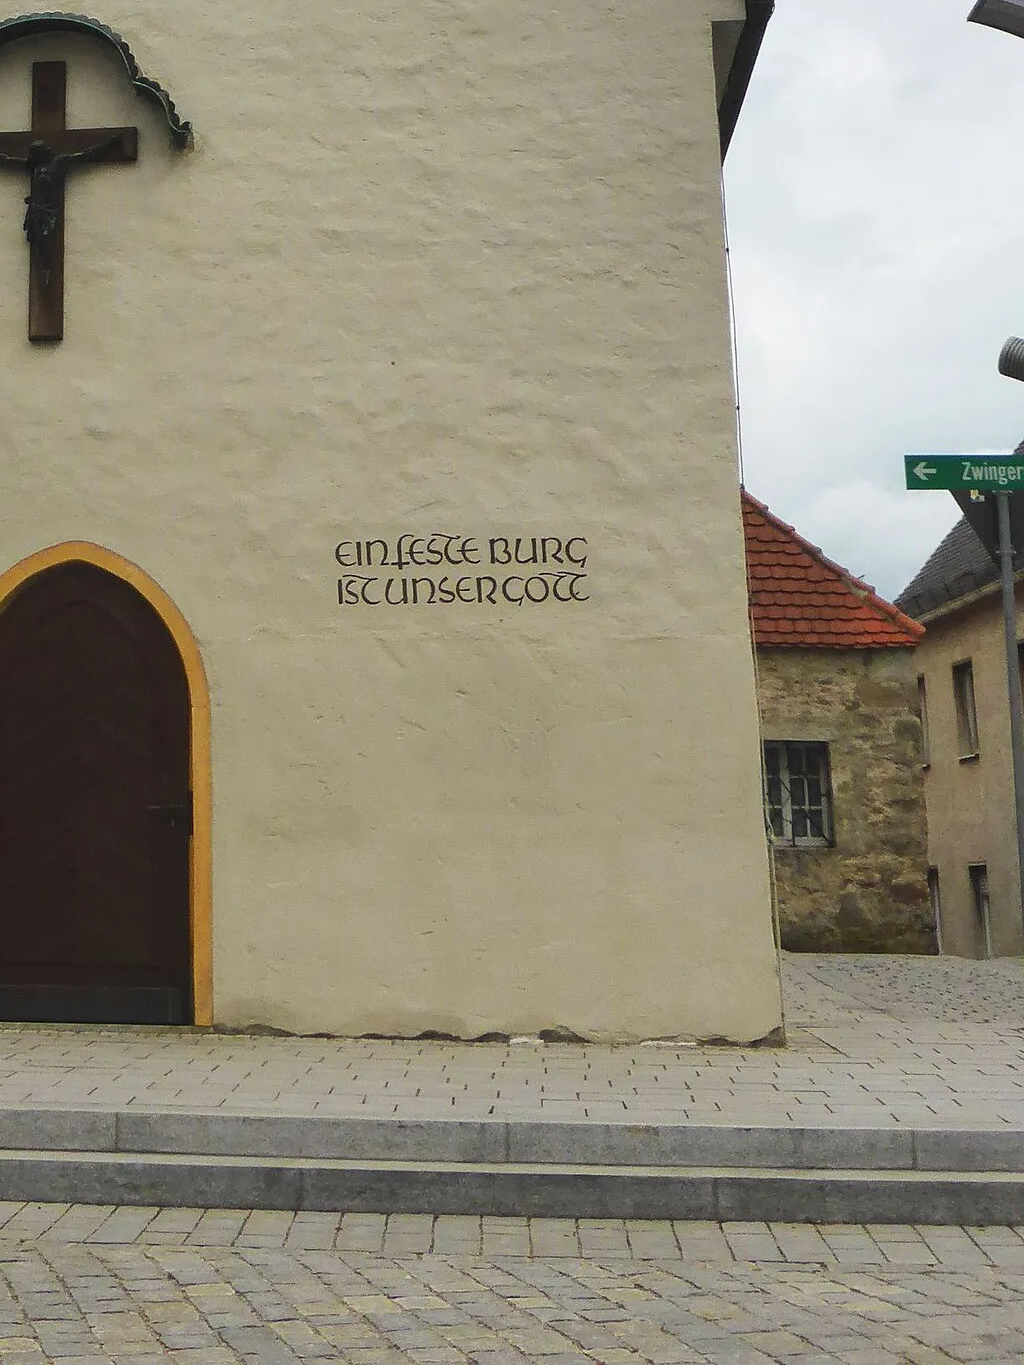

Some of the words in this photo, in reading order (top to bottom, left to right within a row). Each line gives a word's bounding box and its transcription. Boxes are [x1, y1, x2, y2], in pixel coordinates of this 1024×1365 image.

[961, 461, 1024, 485] Zwinger
[488, 536, 589, 569] BURG
[336, 574, 379, 605] IST
[501, 571, 591, 607] GOTT
